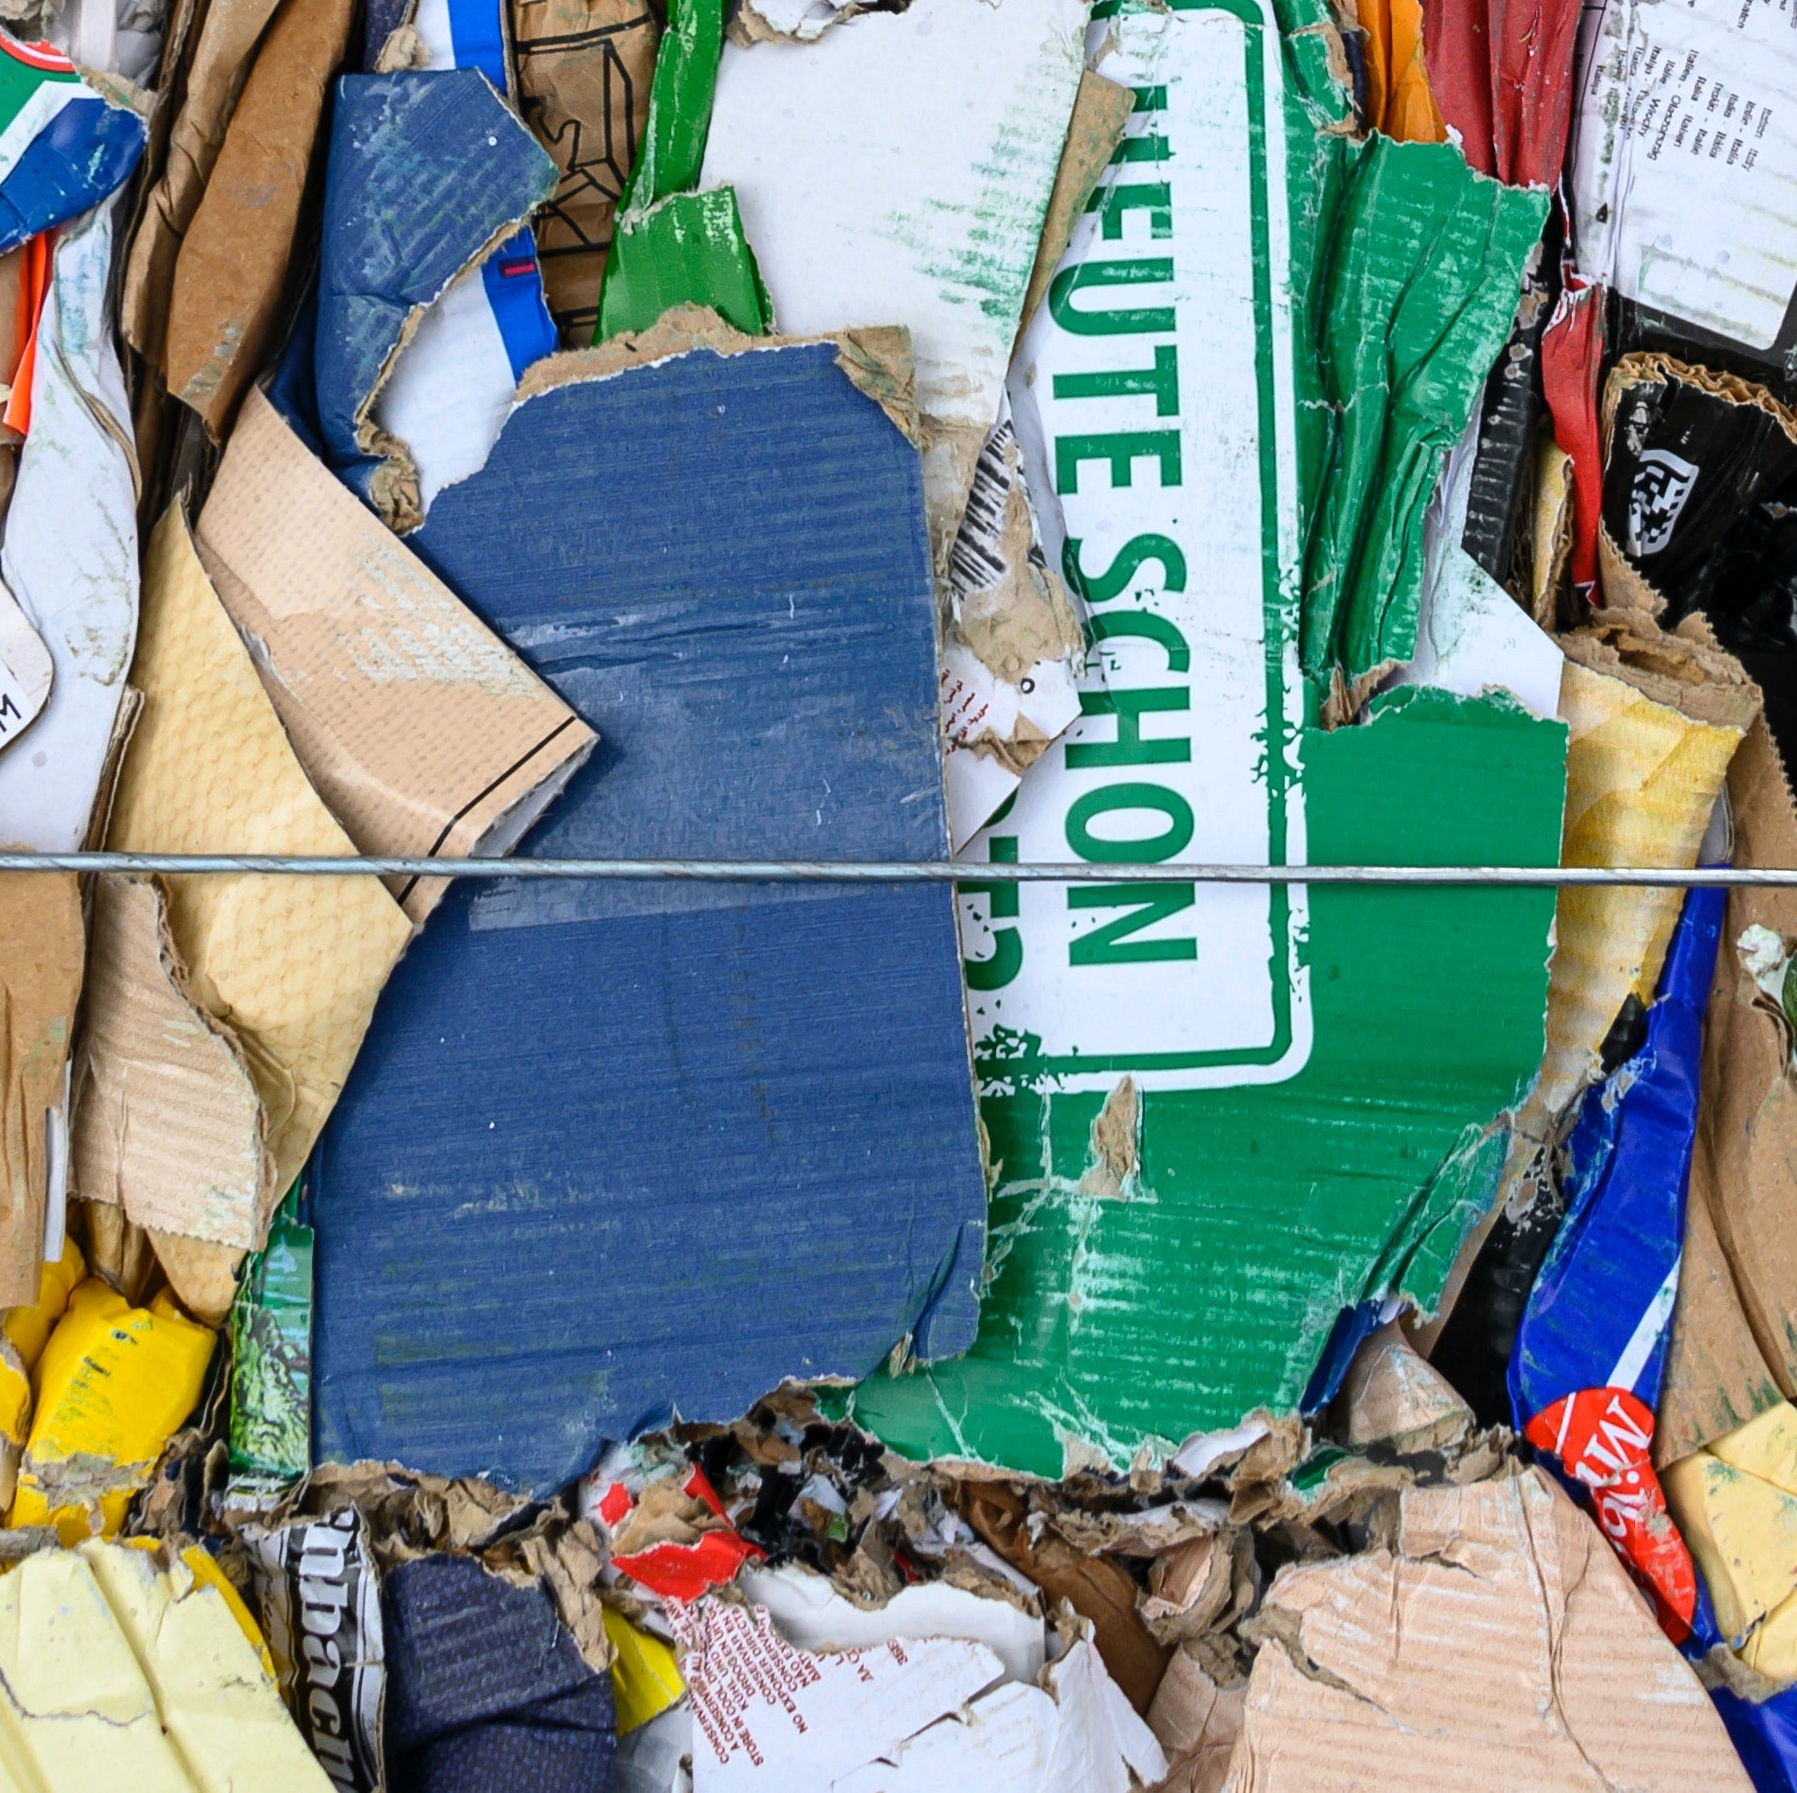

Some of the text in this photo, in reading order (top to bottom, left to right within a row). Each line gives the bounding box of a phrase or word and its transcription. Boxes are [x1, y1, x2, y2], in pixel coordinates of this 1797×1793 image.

[1061, 531, 1198, 968] SCHON
[1574, 1393, 1654, 1553] Milb
[719, 1640, 733, 1658] EN
[723, 1613, 778, 1707] CONSERVAR EN
[710, 1650, 750, 1712] KÜHL UND
[728, 1655, 757, 1698] DROOG
[761, 1658, 798, 1715] EXPONER
[788, 1661, 810, 1689] NÃO
[730, 1709, 744, 1729] IN
[792, 1714, 809, 1735] NO
[737, 1727, 765, 1767] STORE
